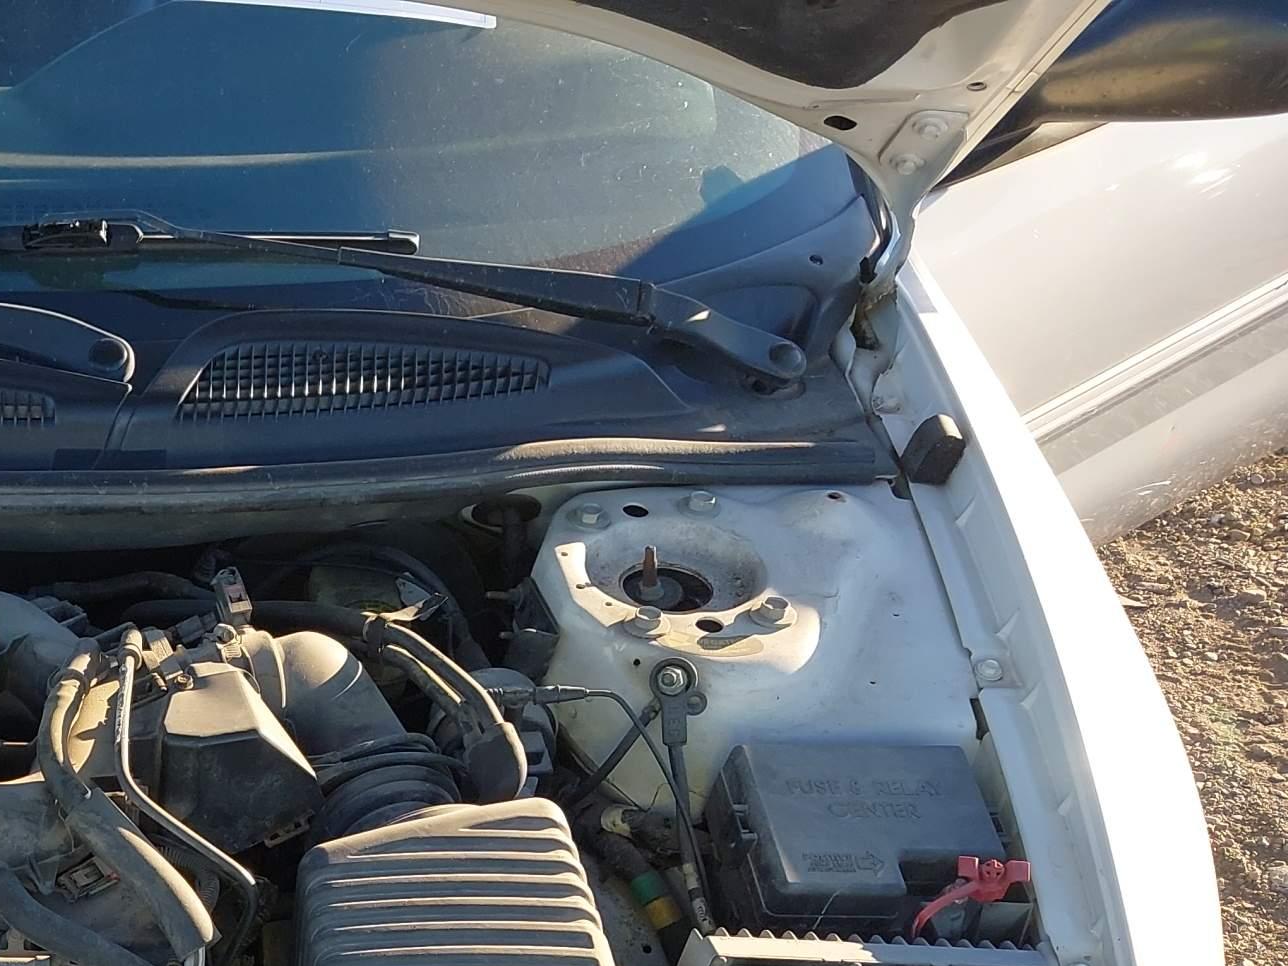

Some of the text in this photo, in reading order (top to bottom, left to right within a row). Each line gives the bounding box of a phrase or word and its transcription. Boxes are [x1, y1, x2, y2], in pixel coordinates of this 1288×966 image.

[785, 779, 841, 795] FUSE
[872, 780, 943, 796] RELAY
[827, 802, 921, 819] CENTER
